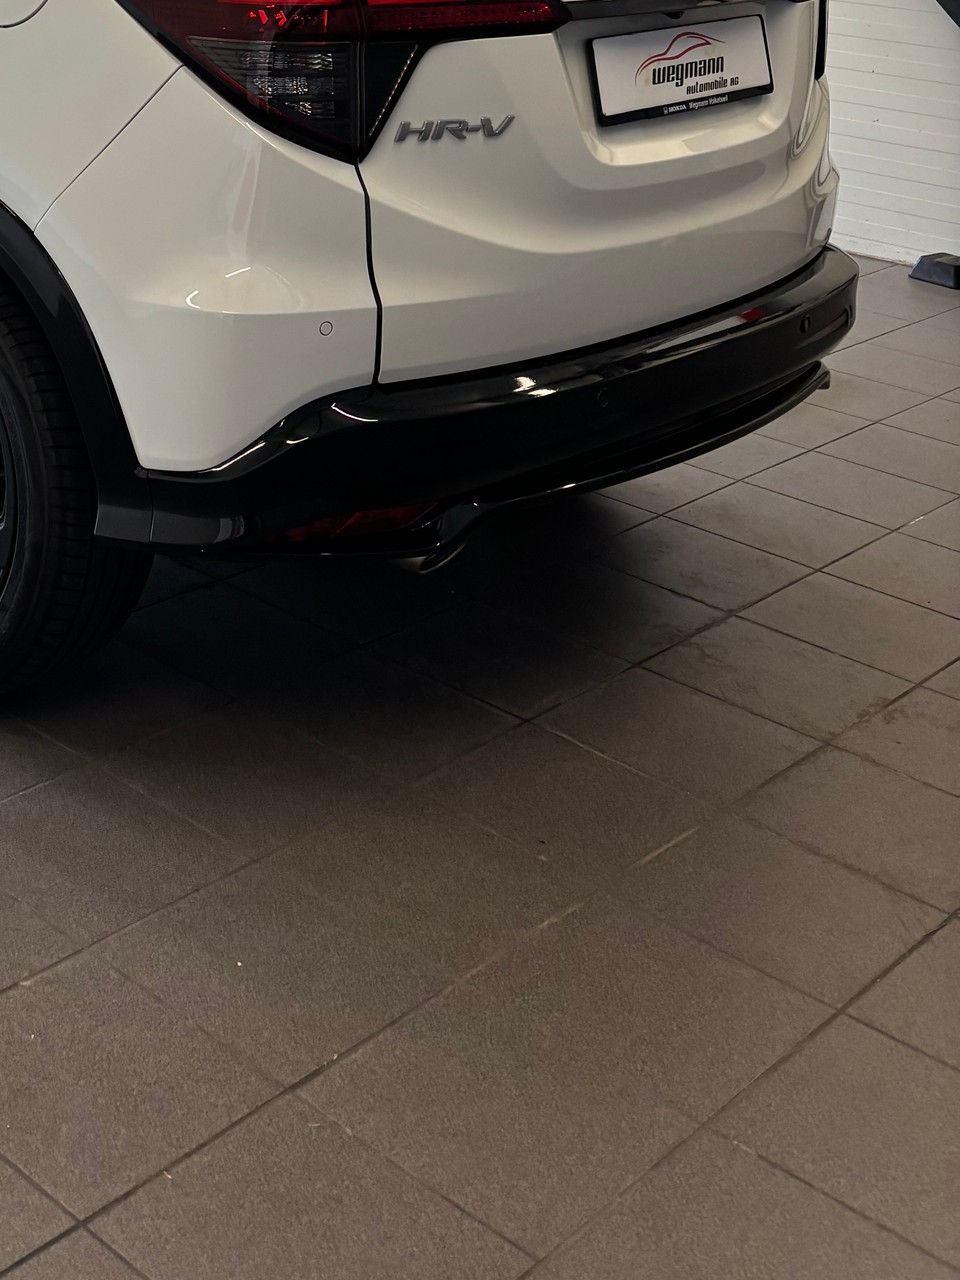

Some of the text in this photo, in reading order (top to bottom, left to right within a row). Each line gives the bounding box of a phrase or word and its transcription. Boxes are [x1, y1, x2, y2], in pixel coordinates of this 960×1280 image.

[652, 56, 724, 88] wegmann
[730, 76, 739, 86] AG
[394, 114, 516, 142] HR-V
